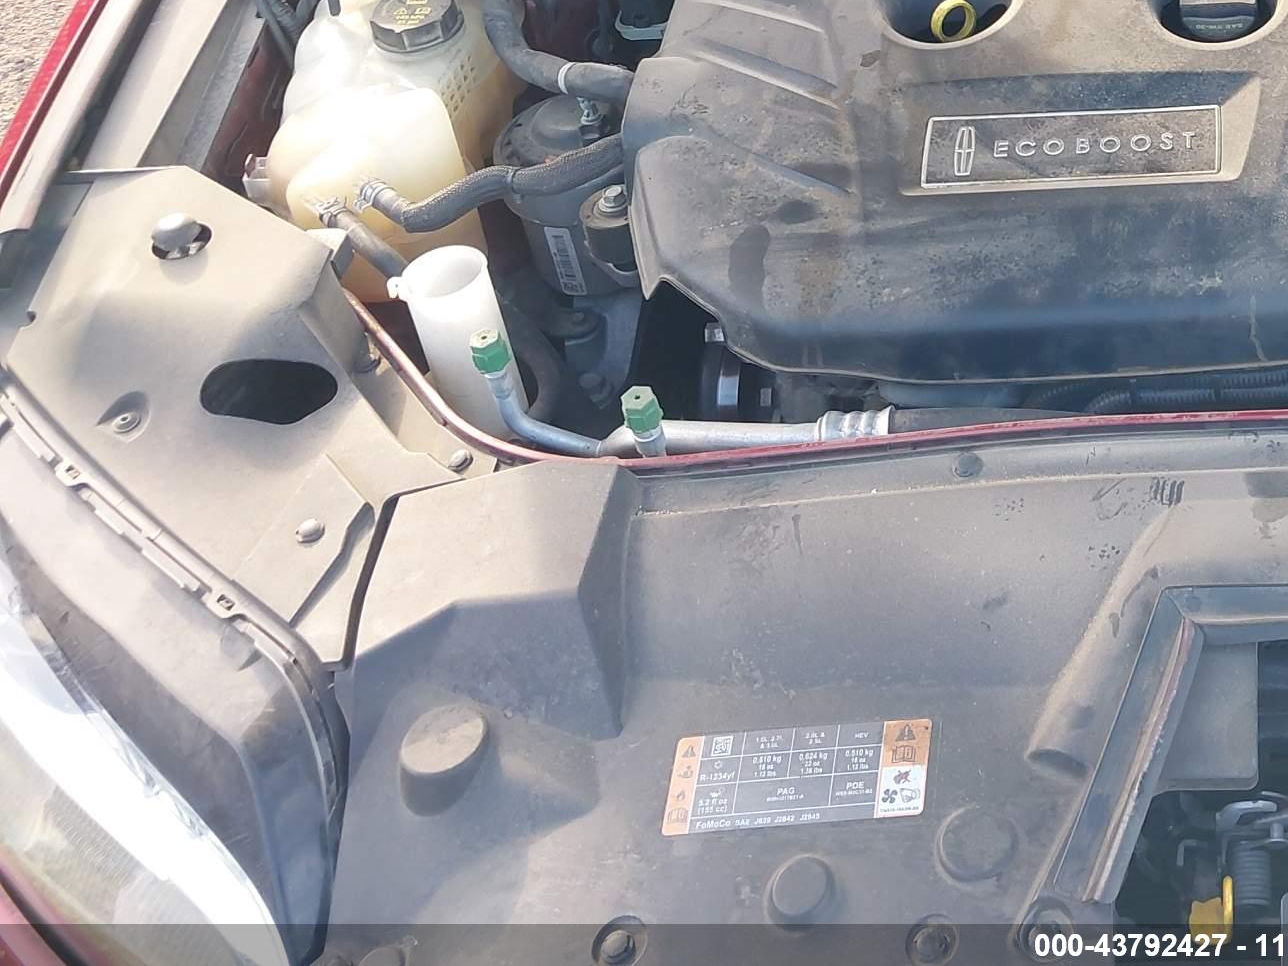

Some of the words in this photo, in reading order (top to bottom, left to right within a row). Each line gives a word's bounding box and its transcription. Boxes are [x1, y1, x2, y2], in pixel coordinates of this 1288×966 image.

[993, 131, 1196, 158] ECOBOOST
[700, 771, 735, 782] R-1234yf
[777, 787, 795, 795] PAG
[696, 818, 731, 829] FoMoCo
